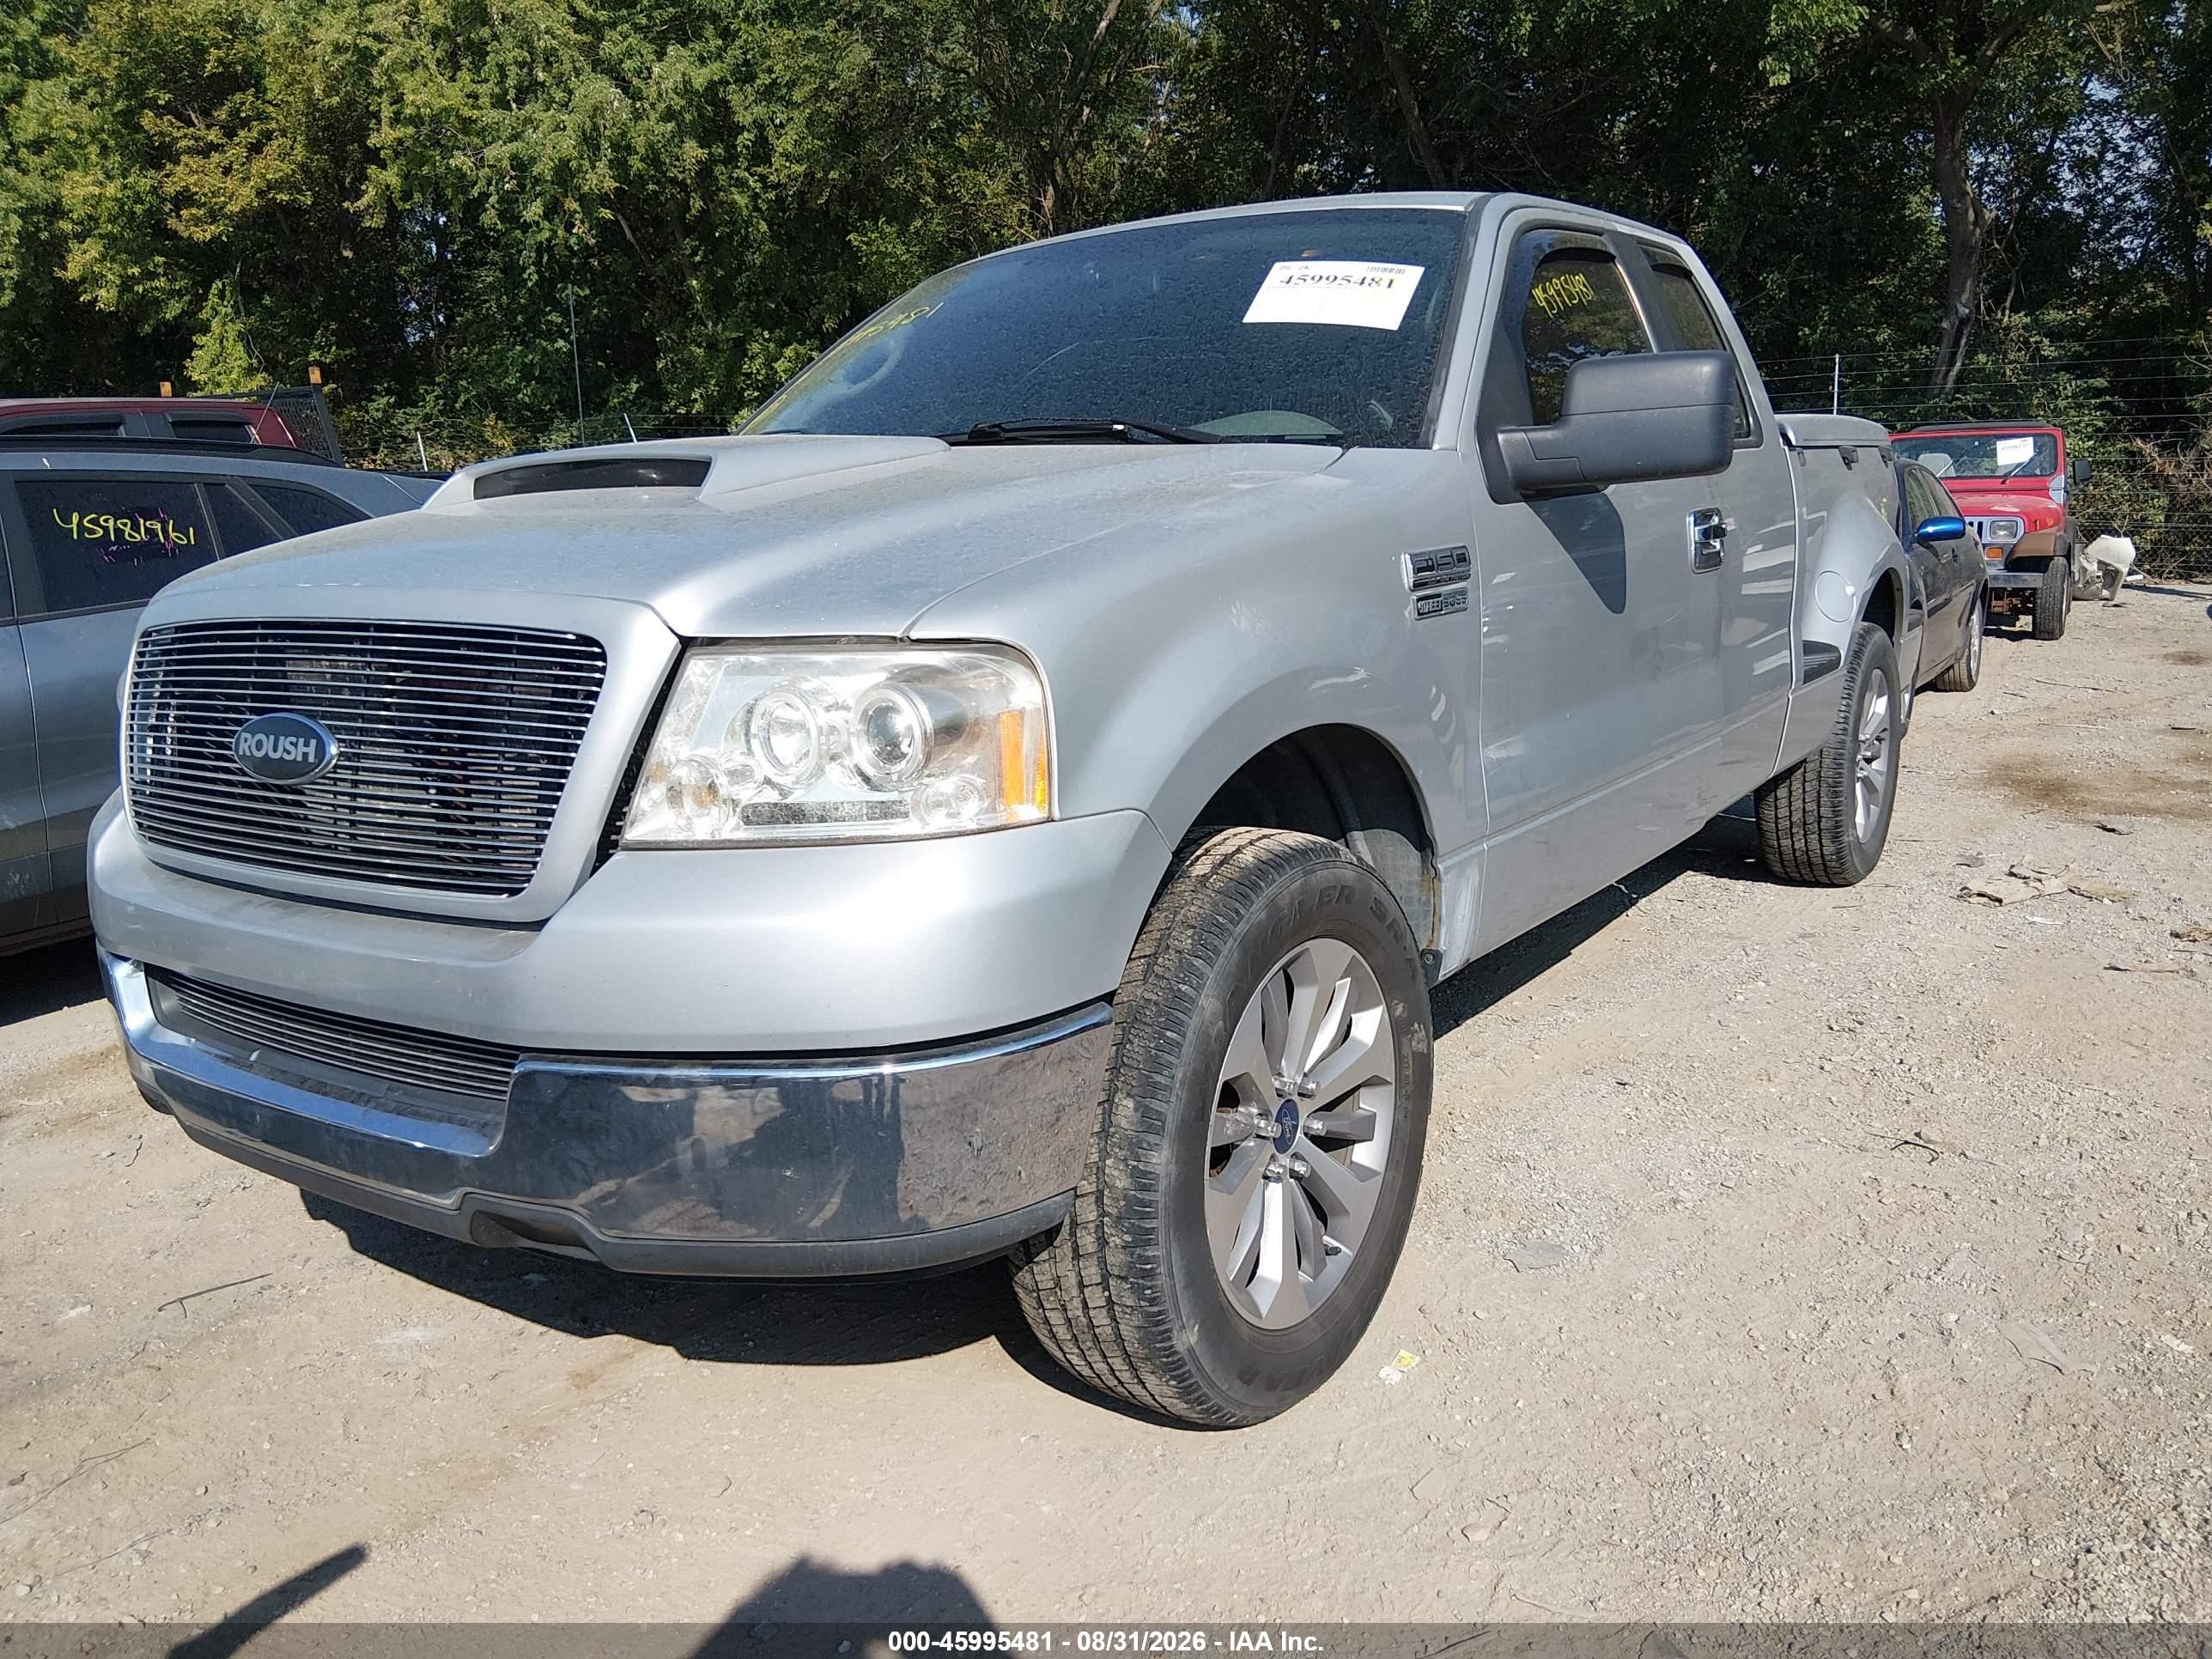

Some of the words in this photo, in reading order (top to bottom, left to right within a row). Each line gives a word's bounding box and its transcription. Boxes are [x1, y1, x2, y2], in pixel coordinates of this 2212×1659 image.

[1279, 274, 1395, 289] 45995481
[1531, 272, 1595, 319] 45995481
[52, 507, 196, 545] 45981961
[239, 732, 317, 763] ROUSH
